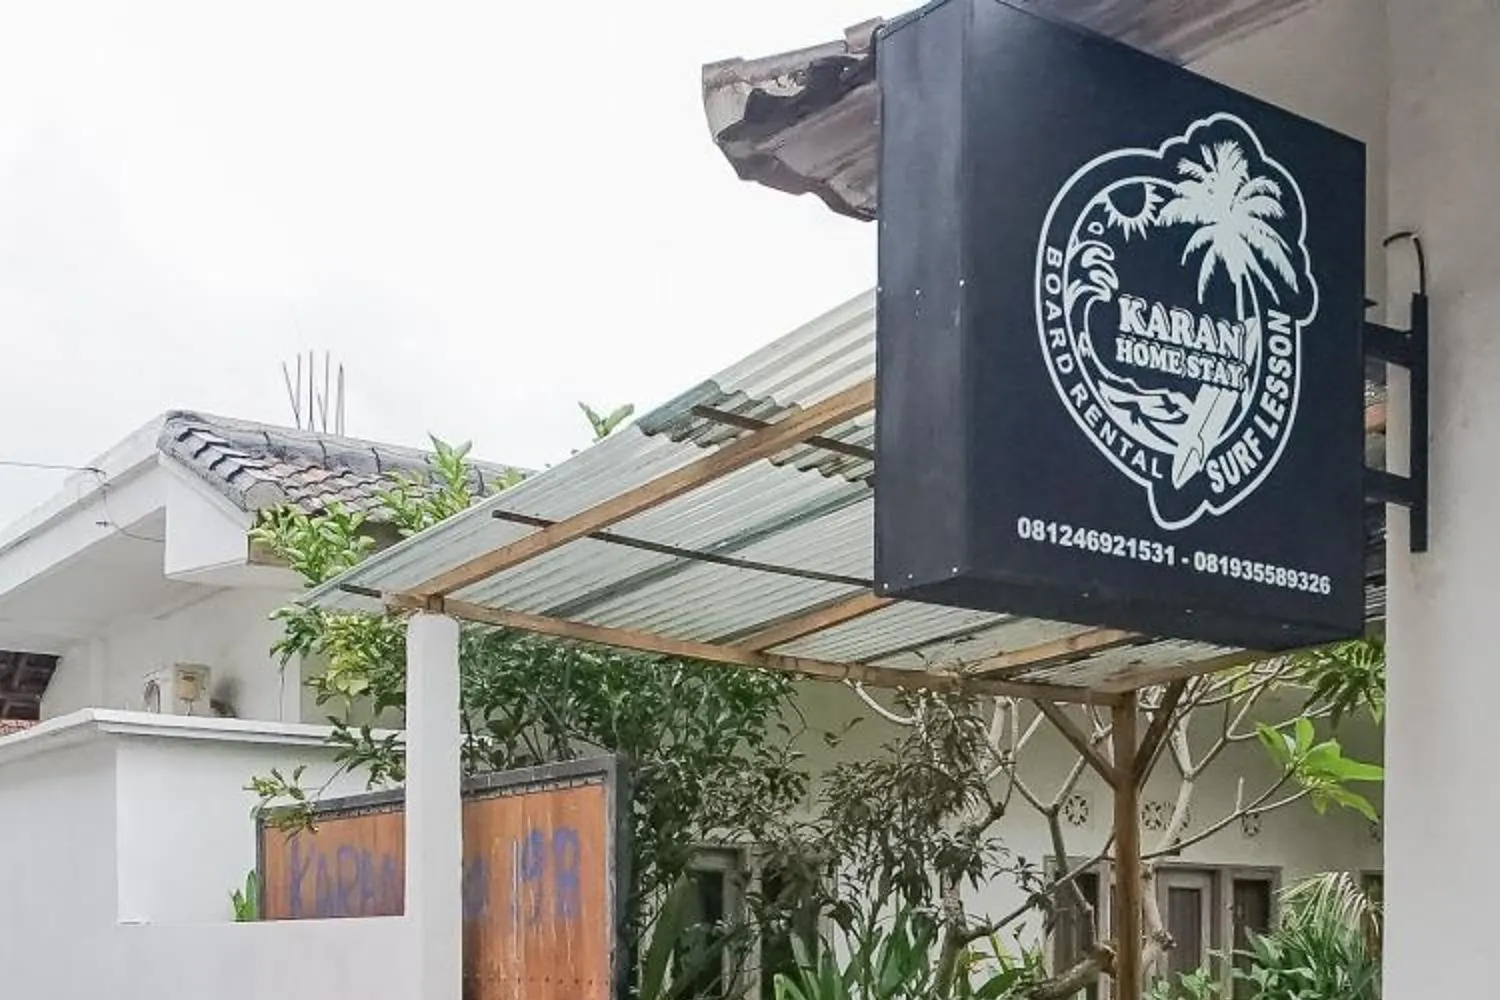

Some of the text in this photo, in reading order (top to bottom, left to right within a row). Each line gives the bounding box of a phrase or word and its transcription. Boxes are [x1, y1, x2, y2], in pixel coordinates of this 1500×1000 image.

[1045, 245, 1164, 479] BOARD RENTAL
[1117, 293, 1245, 362] KARAN
[1206, 308, 1293, 494] SURF LESSON
[1016, 515, 1175, 567] 081246921531
[1193, 550, 1332, 596] 081935589326
